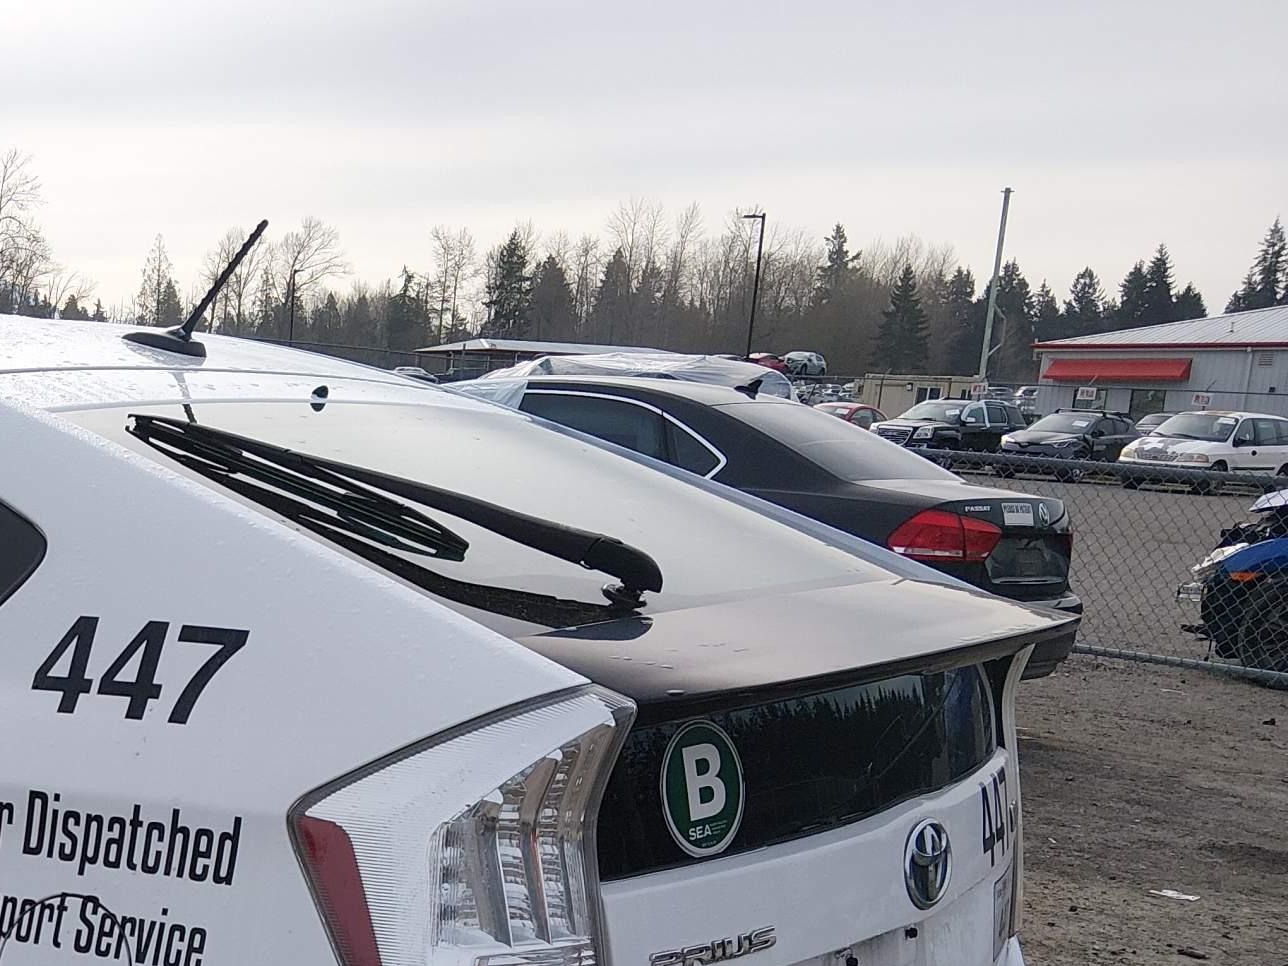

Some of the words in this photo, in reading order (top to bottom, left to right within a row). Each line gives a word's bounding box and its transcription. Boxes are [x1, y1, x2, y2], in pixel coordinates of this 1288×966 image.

[32, 615, 250, 726] 447
[682, 743, 726, 822] B
[979, 766, 1009, 867] 447
[22, 790, 243, 886] Dispatched
[689, 824, 712, 841] SEA
